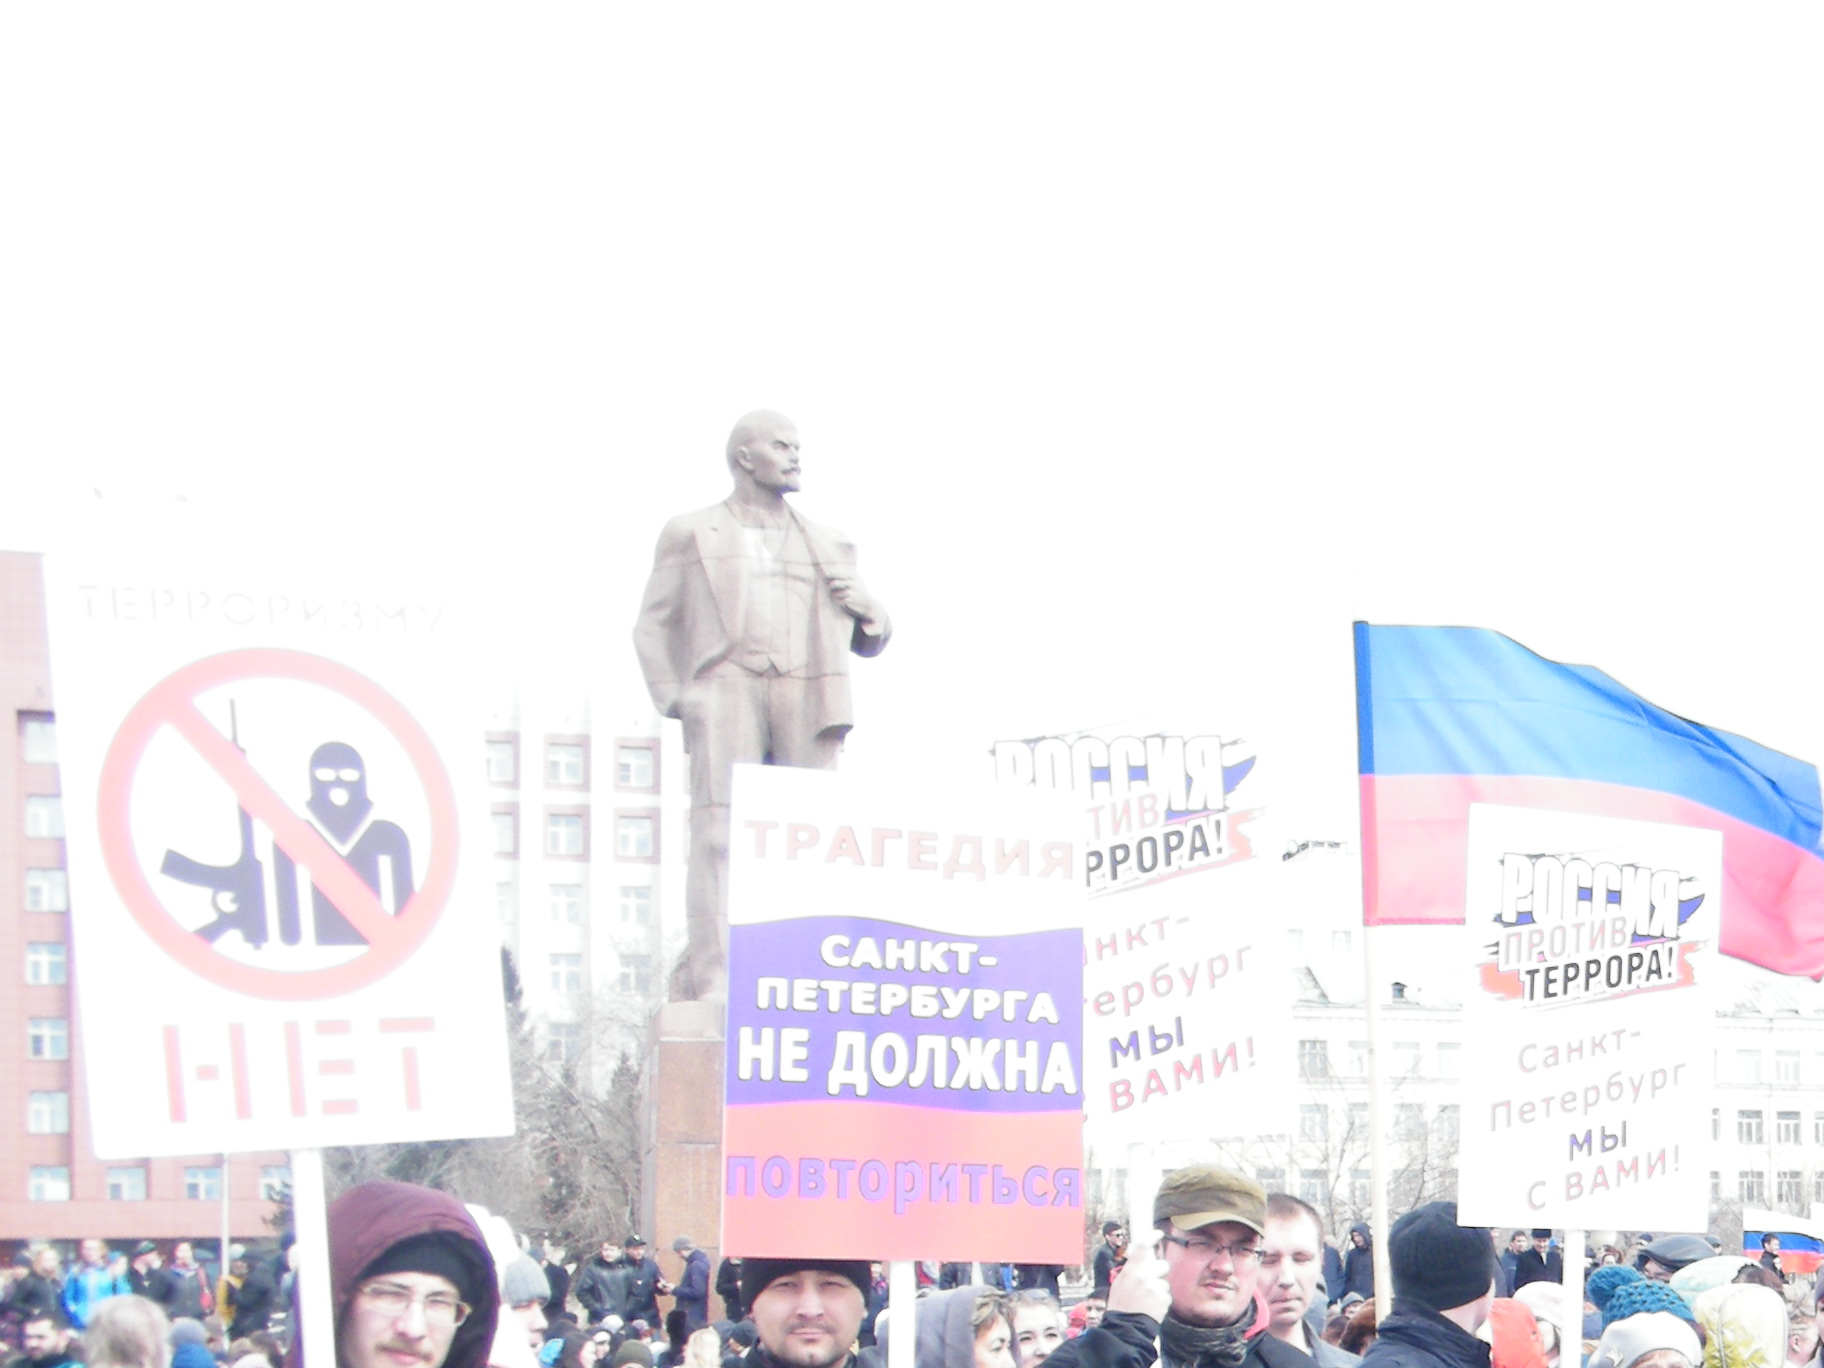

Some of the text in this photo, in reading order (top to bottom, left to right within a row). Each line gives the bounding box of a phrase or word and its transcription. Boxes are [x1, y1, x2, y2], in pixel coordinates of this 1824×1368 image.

[77, 584, 445, 634] ТЕРРОРИЗМУ
[994, 735, 1226, 813] РОССИЯ
[1086, 793, 1160, 842] ТИВ
[744, 820, 1074, 882] ТРАГЕДИЯ
[1086, 819, 1222, 888] РРОРА!
[1501, 852, 1681, 939] РОССИЯ
[820, 934, 998, 975] САНКТ-
[1094, 914, 1190, 962] нкт-
[1503, 915, 1627, 966] ПРОТИВ
[757, 976, 1060, 1025] ПЕТЕРБУРГА
[1092, 945, 1253, 1018] ербург
[1525, 946, 1674, 1002] ТЕРРОРА!
[162, 1016, 436, 1124] НЕТ
[738, 1026, 1078, 1097] НЕ ДОЛЖНА
[1109, 1035, 1256, 1113] ВАМИ!
[1517, 1028, 1641, 1074] Санкт-
[1490, 1062, 1686, 1132] Петербург
[1526, 1144, 1680, 1211] С ВАМИ!
